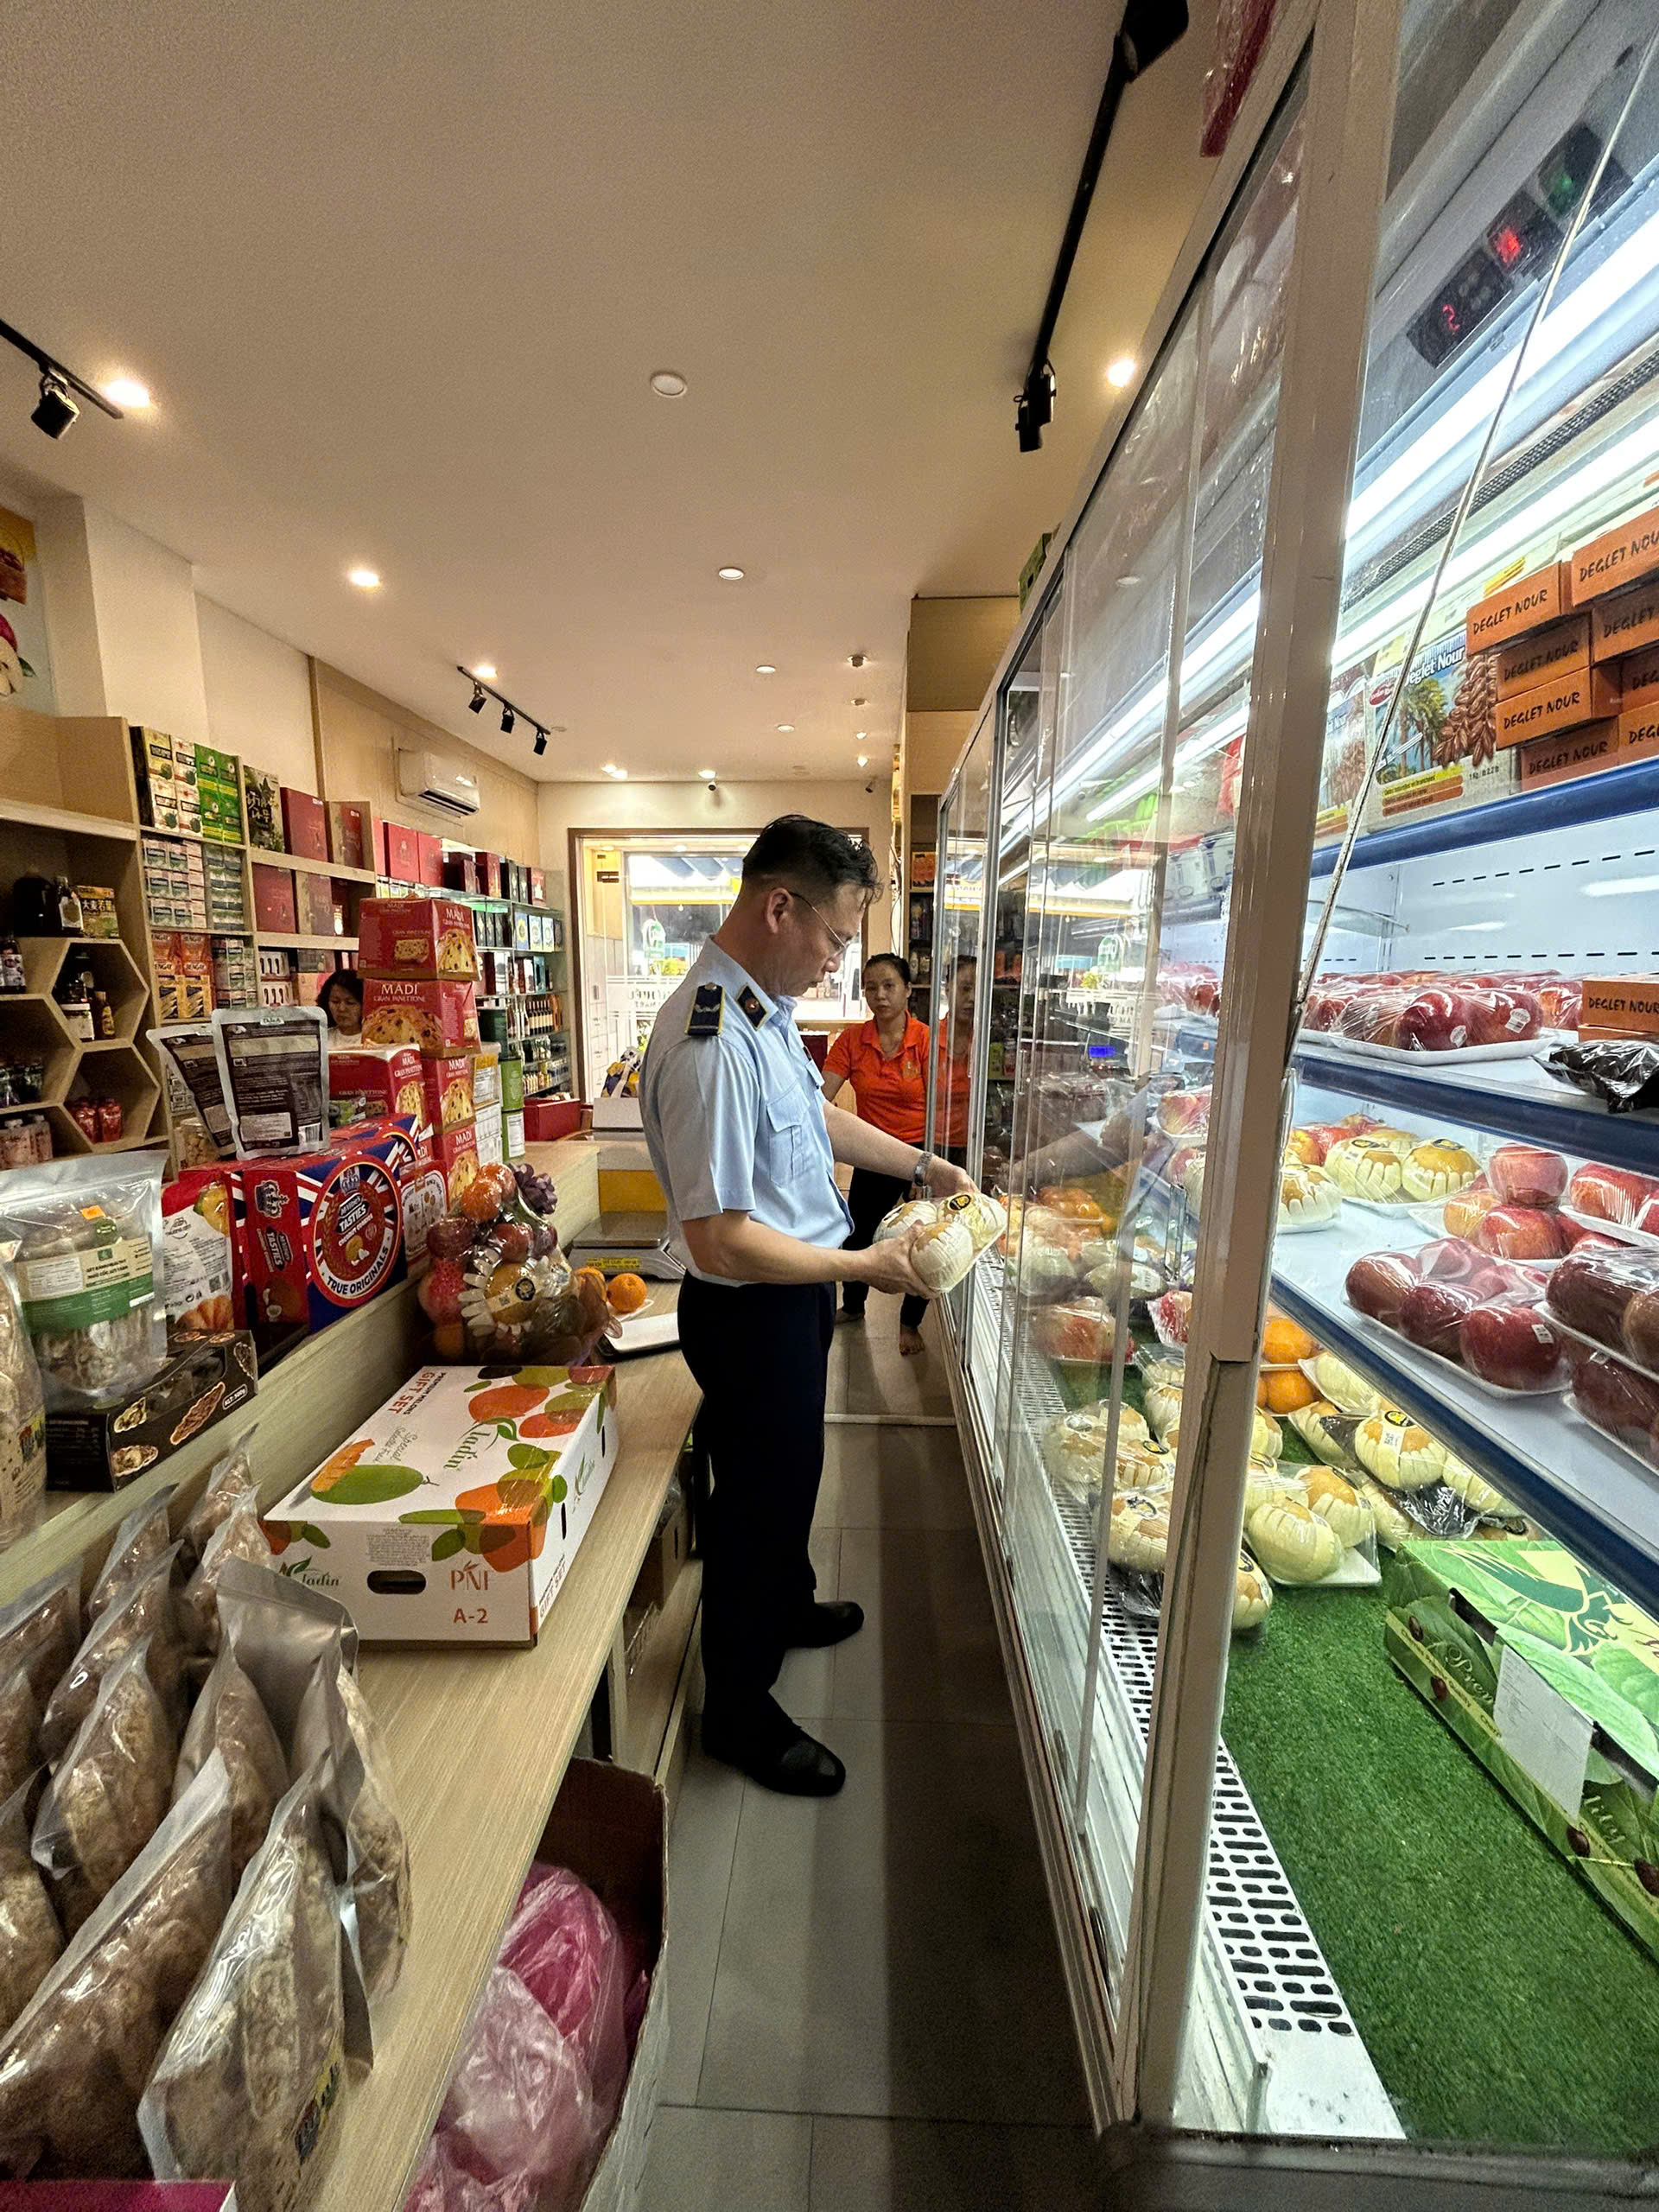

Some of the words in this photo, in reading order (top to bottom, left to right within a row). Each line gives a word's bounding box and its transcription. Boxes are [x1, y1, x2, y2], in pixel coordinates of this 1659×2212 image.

[1580, 546, 1626, 582] DEGLET
[1631, 531, 1659, 556] NOU
[1473, 607, 1511, 635] DEGLET
[1516, 589, 1548, 615] NOUR
[1604, 607, 1656, 638] DEGLET
[1406, 661, 1436, 686] eglet
[1437, 647, 1465, 671] Nour
[1504, 658, 1542, 681] DEGLET
[1547, 640, 1580, 664] NOUR
[1633, 670, 1659, 690] DEG
[1504, 705, 1542, 730] DEGLET
[1547, 692, 1580, 715] NOUR
[1529, 753, 1569, 775] DEGLET
[1573, 741, 1609, 761] NOUR
[1588, 997, 1625, 1011] DEGLET
[1630, 1001, 1659, 1014] NOUR
[340, 1204, 366, 1232] TASTIES
[266, 1231, 283, 1266] TASTIES
[327, 1275, 348, 1294] TRUE
[350, 1247, 389, 1294] ORIGINALS
[409, 1371, 435, 1394] GIFT
[388, 1395, 414, 1414] SET
[451, 1567, 489, 1591] PNI
[454, 1608, 489, 1624] A-2
[1584, 1796, 1625, 1843] lity
